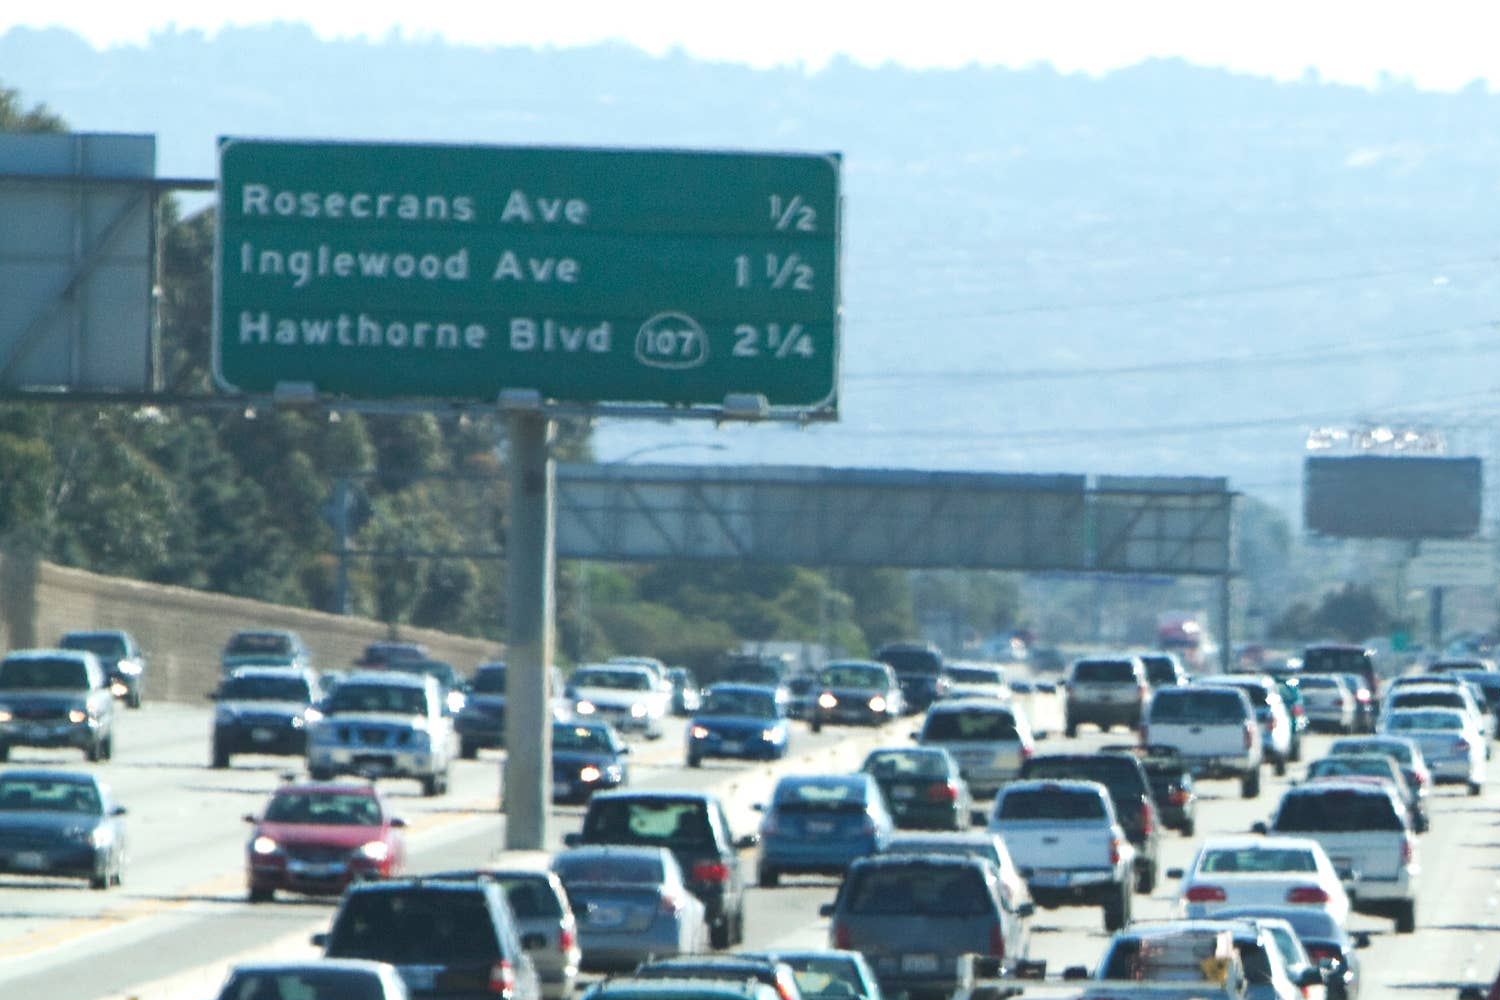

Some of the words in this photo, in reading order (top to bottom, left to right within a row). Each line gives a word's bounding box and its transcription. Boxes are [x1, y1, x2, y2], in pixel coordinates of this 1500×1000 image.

[242, 184, 475, 221] Rosecrans
[501, 189, 589, 224] Ave
[241, 242, 469, 288] Inglewood
[493, 250, 581, 283] Ave
[239, 311, 487, 350] Hawthorne
[509, 317, 612, 352] Blvd
[645, 330, 694, 355] 107
